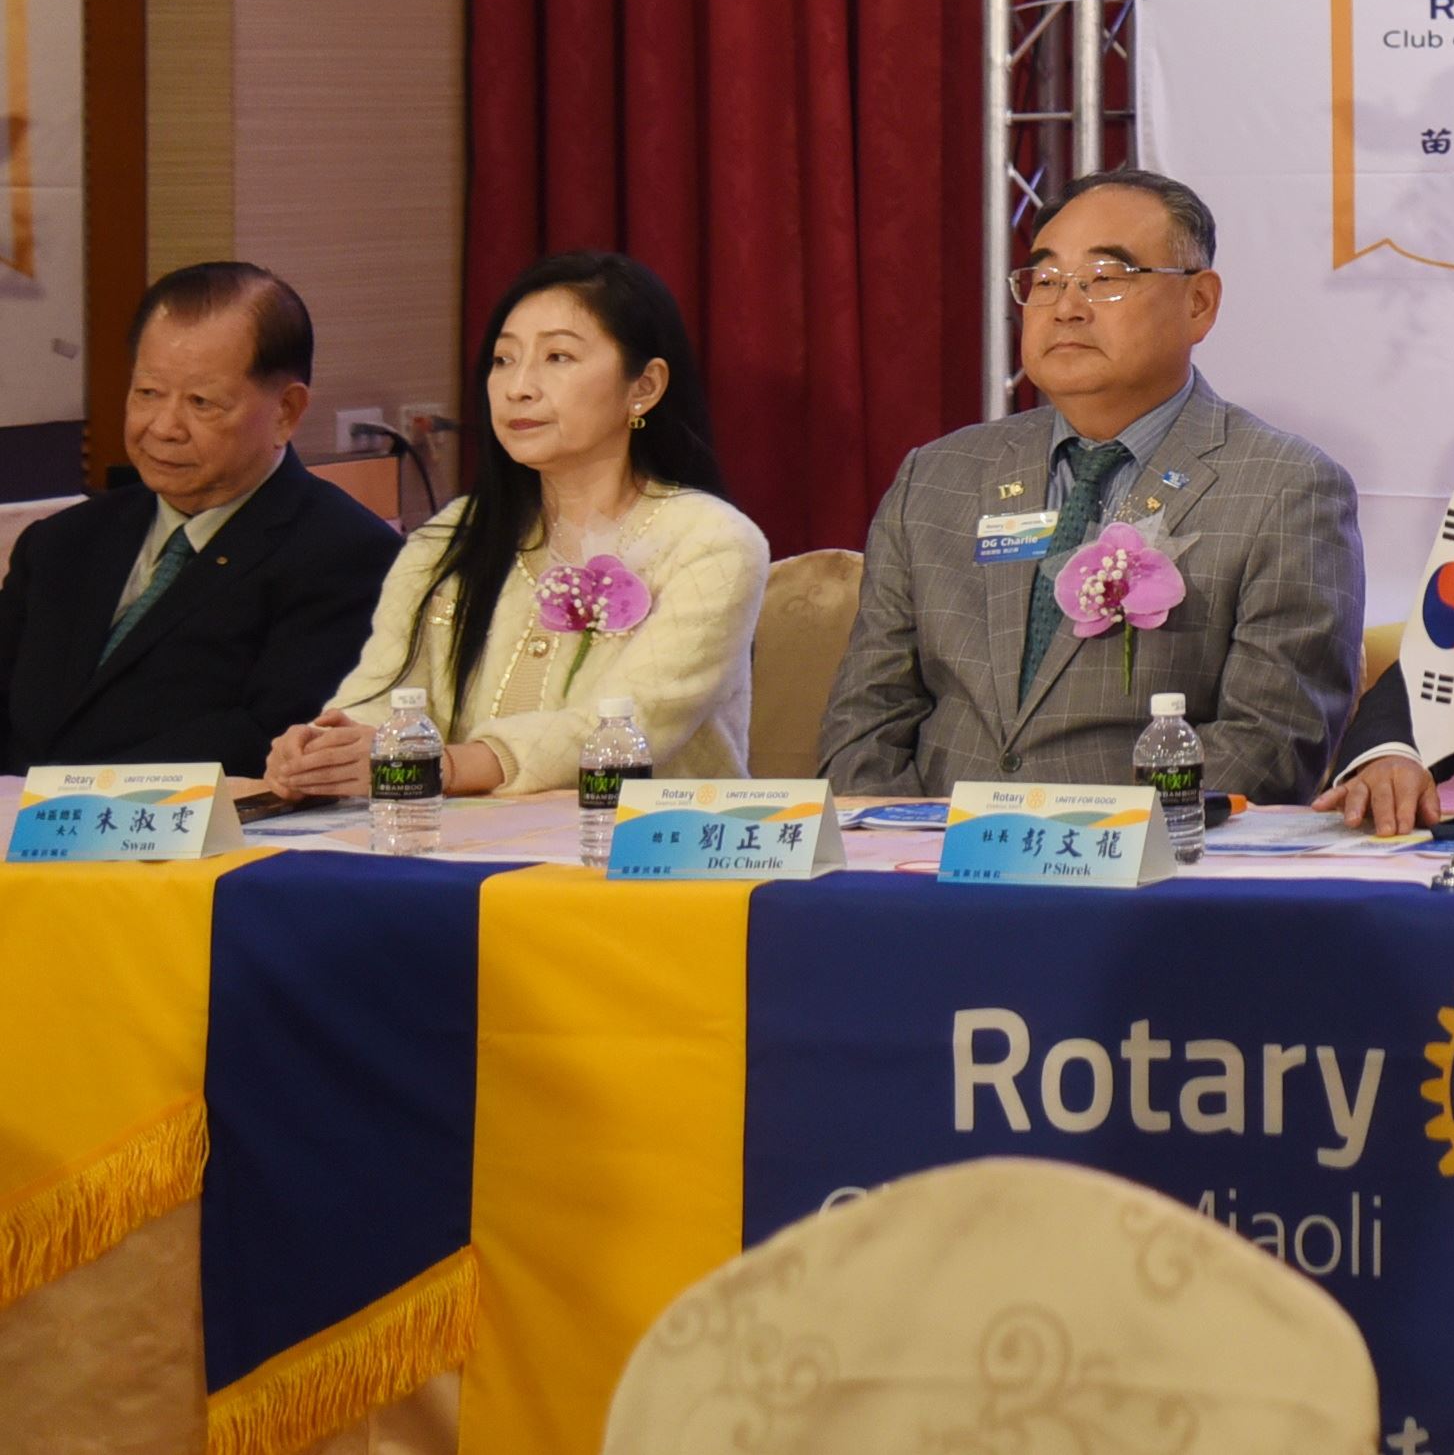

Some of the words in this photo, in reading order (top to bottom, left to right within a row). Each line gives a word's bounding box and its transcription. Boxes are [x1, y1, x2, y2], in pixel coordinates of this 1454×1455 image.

[1383, 29, 1444, 50] Club
[64, 773, 96, 786] Rotary
[661, 788, 694, 802] Rotary
[992, 791, 1025, 806] Rotary
[120, 839, 156, 851] Swan
[698, 823, 803, 852] 劉正輝
[1022, 827, 1122, 860] 彭文龍
[707, 856, 732, 870] DG
[733, 855, 784, 870] Charlie
[1052, 862, 1091, 877] Shrek
[951, 1007, 1386, 1170] Rotary
